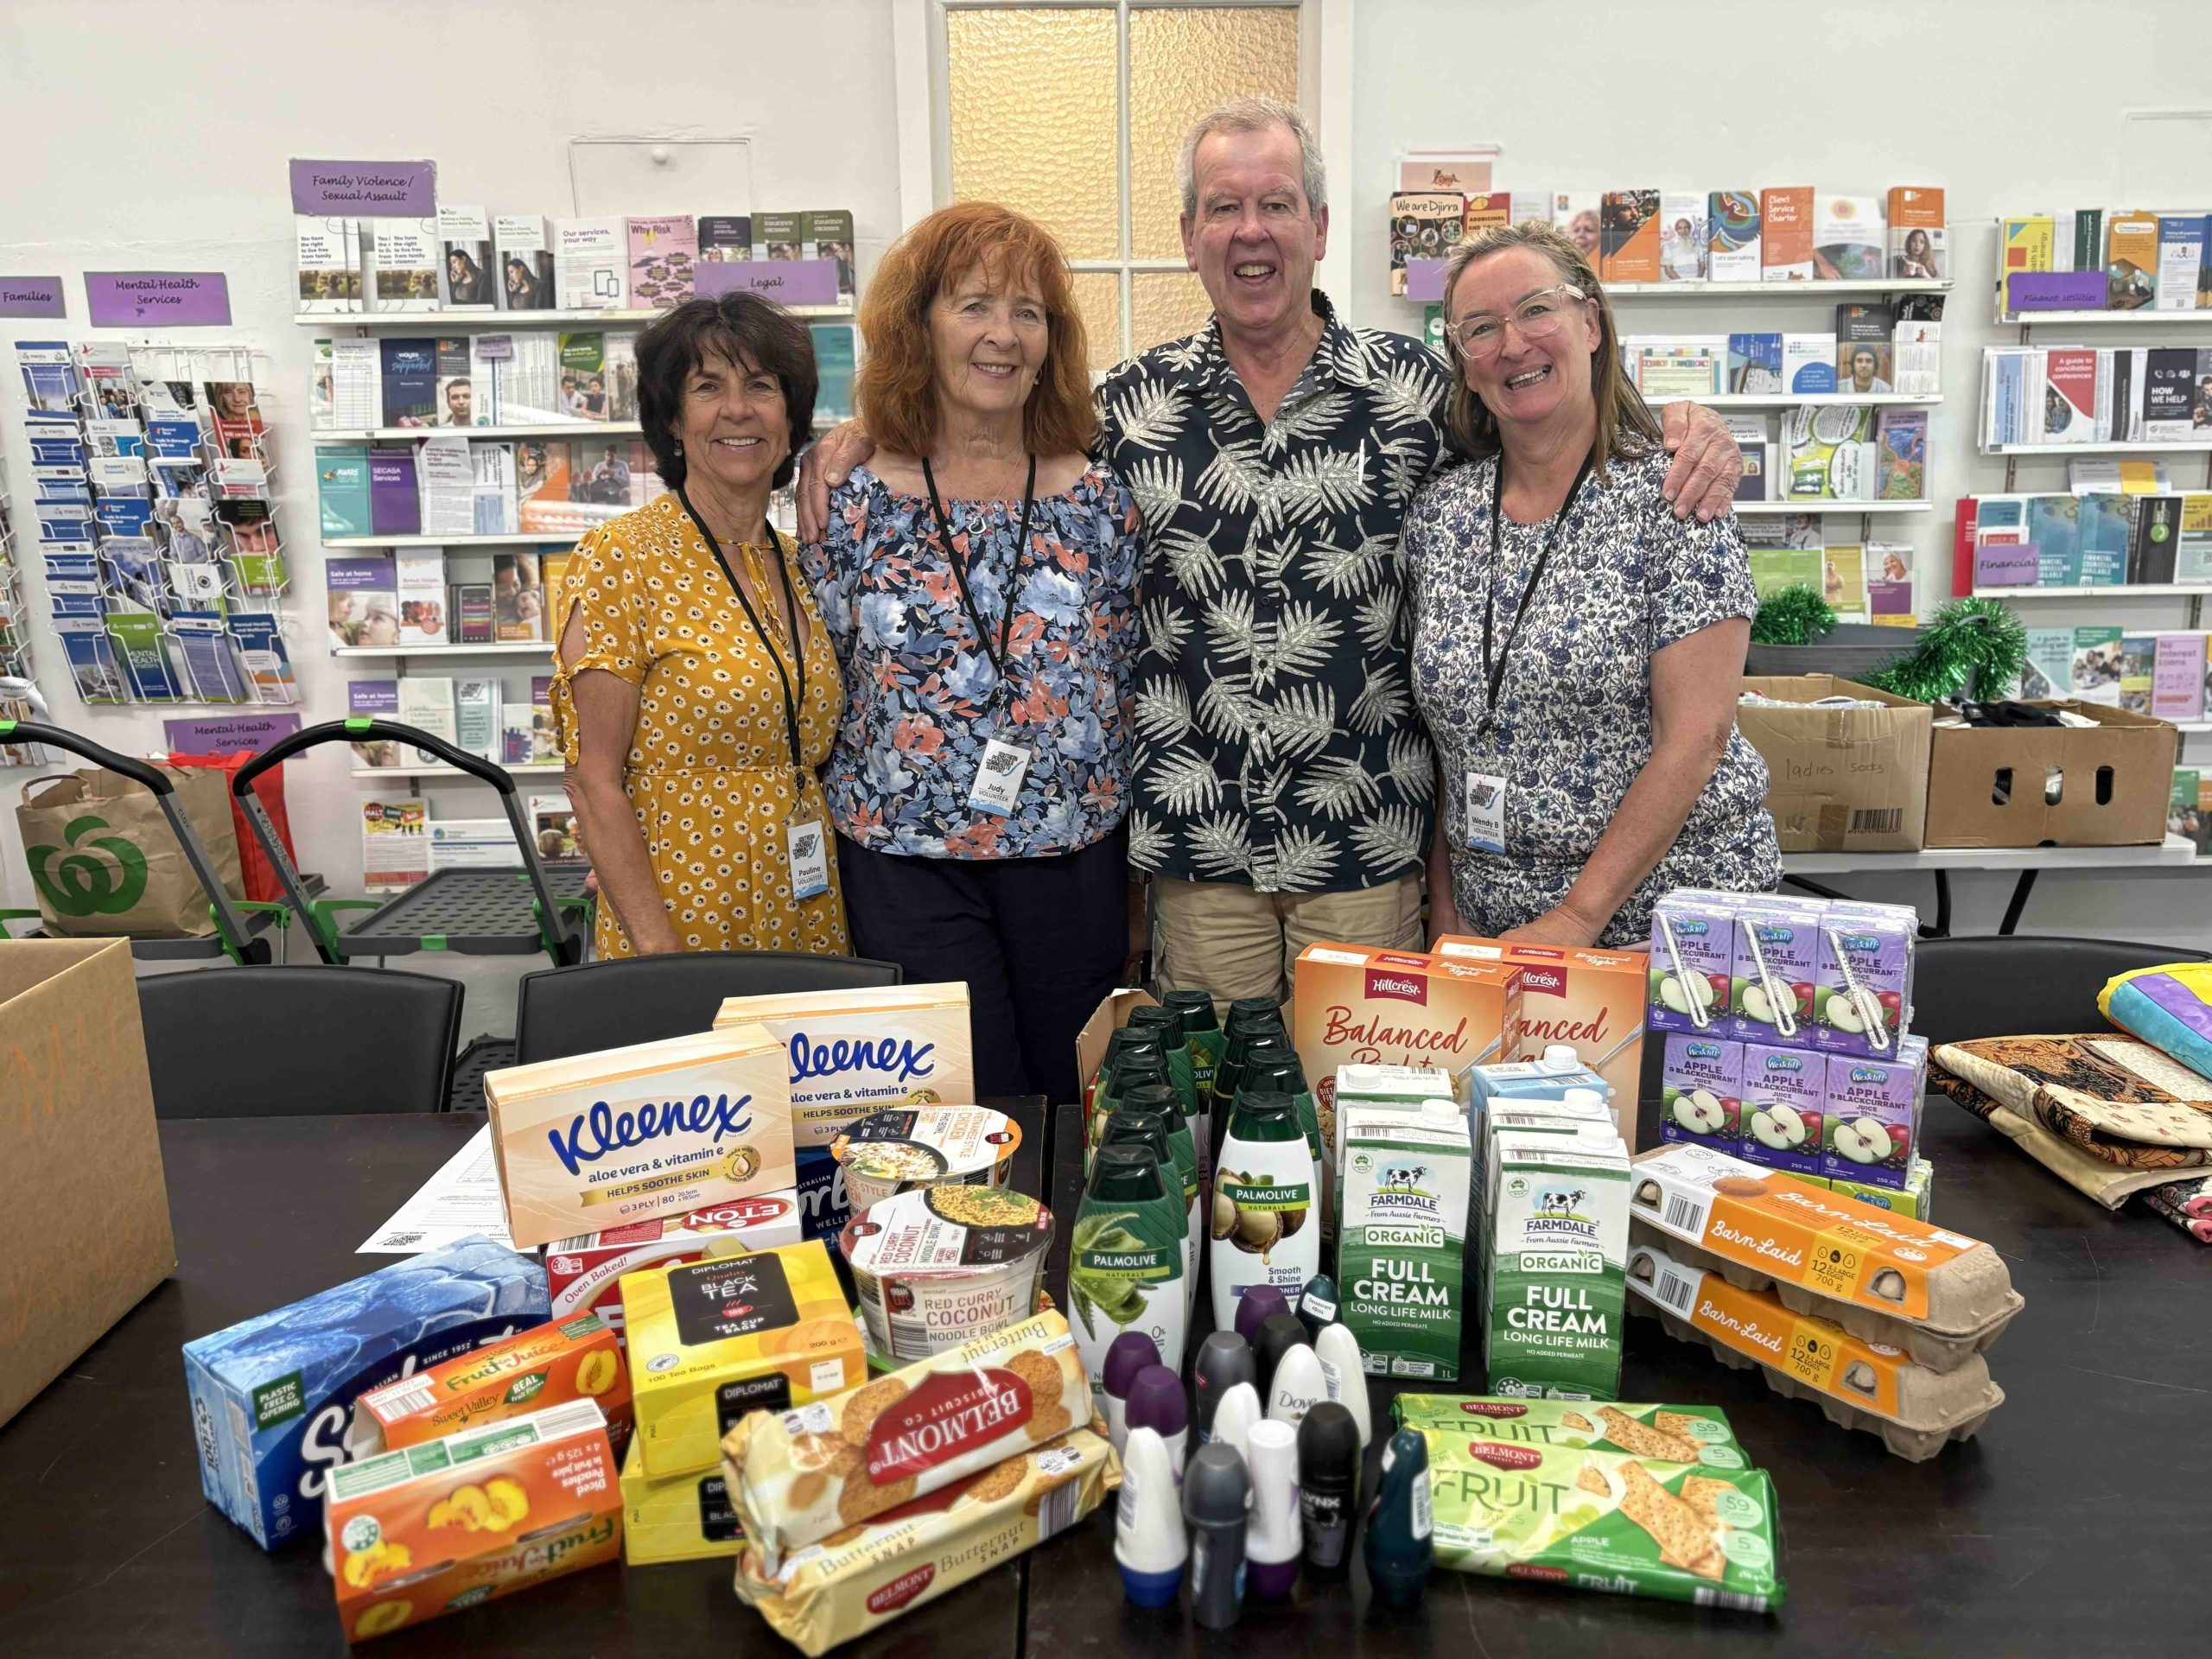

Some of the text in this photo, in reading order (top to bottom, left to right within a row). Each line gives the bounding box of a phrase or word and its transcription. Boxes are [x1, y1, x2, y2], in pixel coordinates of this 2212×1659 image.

[313, 175, 353, 188] Family
[321, 191, 408, 200] Sexual Assault
[1769, 195, 1790, 204] Client
[1395, 200, 1459, 214] We are Djirra
[1768, 204, 1796, 213] Service
[1768, 213, 1798, 222] Charter
[579, 228, 611, 238] services,
[631, 225, 671, 236] Why Risk
[115, 279, 200, 290] Mental Health
[751, 277, 785, 288] Legal
[3, 291, 53, 302] Families
[137, 294, 182, 306] Services
[1980, 559, 2037, 570] Financial
[194, 721, 276, 735] Mental Health
[216, 738, 260, 747] Services
[1787, 759, 1884, 779] ladies socks
[979, 791, 1008, 802] VOLUNTEER
[988, 784, 1005, 795] Judy
[365, 808, 384, 817] HALT
[1471, 817, 1493, 829] Wendy
[1473, 828, 1498, 837] VOLUNTEER
[798, 874, 823, 885] VOLUNTEER
[799, 866, 821, 877] Pauline
[1372, 977, 1421, 996] Hillcrest
[1324, 1006, 1468, 1054] Balanced
[788, 1032, 935, 1084] leenex
[1675, 1067, 1737, 1084] BLACKCURRANT
[1684, 1061, 1723, 1075] APPLE
[1837, 1094, 1906, 1110] BLACKCURRANT
[1846, 1086, 1890, 1101] APPLE
[1856, 1104, 1878, 1113] JUICE
[548, 1094, 753, 1176] Kleenex
[588, 1147, 724, 1184] aloe vera & vitamin e
[607, 1169, 710, 1198] HELPS SOOTHE SKIN
[1236, 1188, 1298, 1201] PALMOLIVE
[1370, 1194, 1437, 1211] FARMDALE
[1526, 1220, 1596, 1236] FARMDALE
[1776, 1191, 1936, 1250] Barn Laid
[1367, 1228, 1441, 1245] ORGANIC
[1710, 1220, 1803, 1268] Barn Laid
[691, 1258, 757, 1274] DIPLOMAT
[1093, 1255, 1158, 1267] PALMOLIVE
[1522, 1255, 1600, 1271] ORGANIC
[1811, 1258, 1828, 1274] 12
[1268, 1267, 1301, 1275] Smooth
[1278, 1274, 1301, 1283] Shine
[1371, 1257, 1435, 1284] FULL
[1827, 1270, 1844, 1281] EGGS
[563, 1256, 629, 1305] Oven Baked!
[701, 1275, 757, 1291] BLACK
[703, 1283, 759, 1300] TEA
[925, 1287, 1002, 1310] RED CURRY
[1353, 1280, 1449, 1306] CREAM
[1526, 1285, 1592, 1311] FULL
[925, 1295, 1016, 1327] COCONUT
[1351, 1301, 1452, 1319] LONG LIFE MILK
[1507, 1306, 1606, 1334] CREAM
[1699, 1300, 1783, 1353] Barn Laid
[725, 1324, 757, 1334] BAGS
[929, 1319, 1010, 1341] NOODLE BOWL
[961, 1321, 1049, 1364] Butternut
[1503, 1330, 1609, 1349] LONG LIFE MILK
[423, 1341, 471, 1364] SINCE 1952
[647, 1374, 668, 1383] 100
[689, 1363, 715, 1375] Bags
[259, 1380, 297, 1403] PLASTIC
[512, 1375, 539, 1394] REAL
[724, 1379, 780, 1401] DIPLOMAT
[264, 1396, 285, 1409] FREE
[1279, 1390, 1318, 1409] Dove
[259, 1398, 302, 1421] OPENING
[432, 1394, 500, 1427] Sweet Valley
[1465, 1403, 1522, 1414] BELMONT
[880, 1388, 1022, 1467] BELMONT
[1474, 1446, 1538, 1463] BELMONT
[562, 1467, 604, 1487] Peaches
[576, 1478, 606, 1497] Diced
[1433, 1469, 1569, 1515] FRUIT
[1300, 1489, 1342, 1508] LYNX
[818, 1522, 917, 1577] Butternut
[939, 1521, 1027, 1574] Butternut
[1571, 1536, 1610, 1547] APPLE
[871, 1569, 931, 1608] BELMONT
[1578, 1573, 1638, 1593] FRUIT
